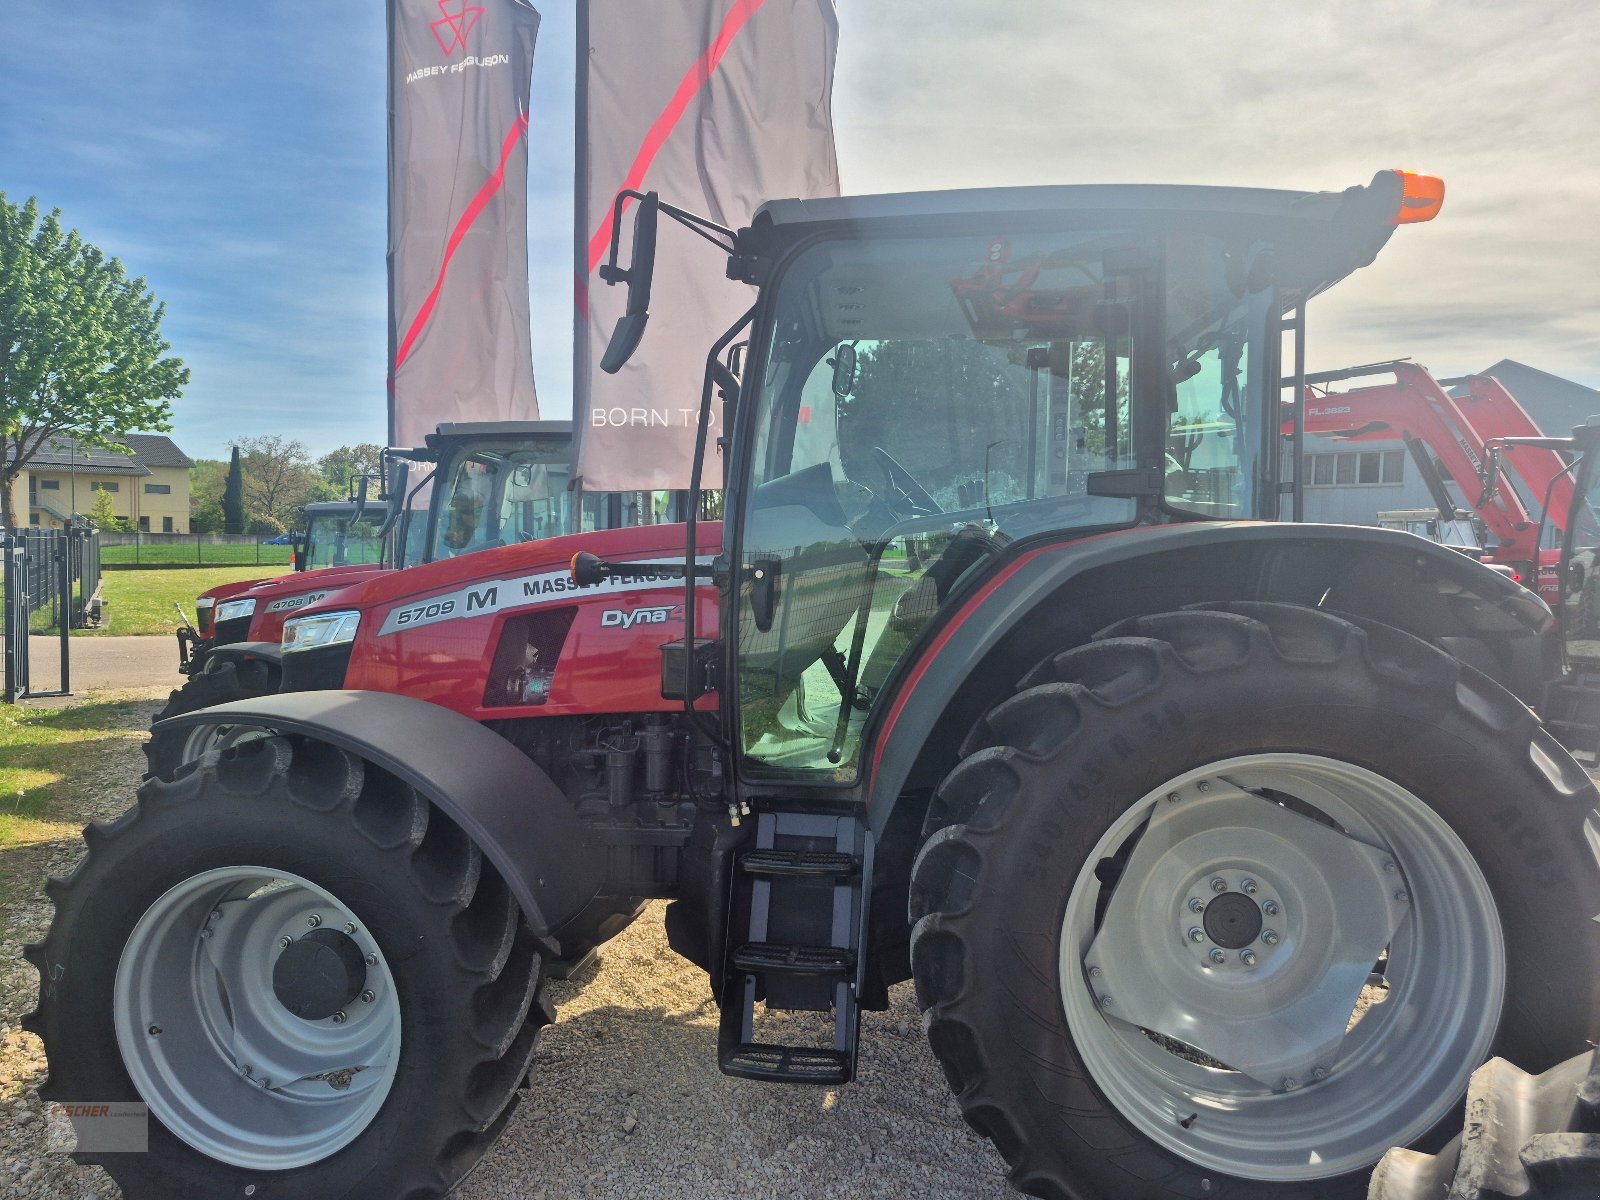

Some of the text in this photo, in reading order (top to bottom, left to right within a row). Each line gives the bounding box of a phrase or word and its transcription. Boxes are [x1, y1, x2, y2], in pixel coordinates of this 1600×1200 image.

[406, 65, 448, 84] MASSEY
[592, 407, 715, 427] BORN TO
[272, 598, 304, 609] 4708
[397, 577, 600, 625] 5709 M MASS
